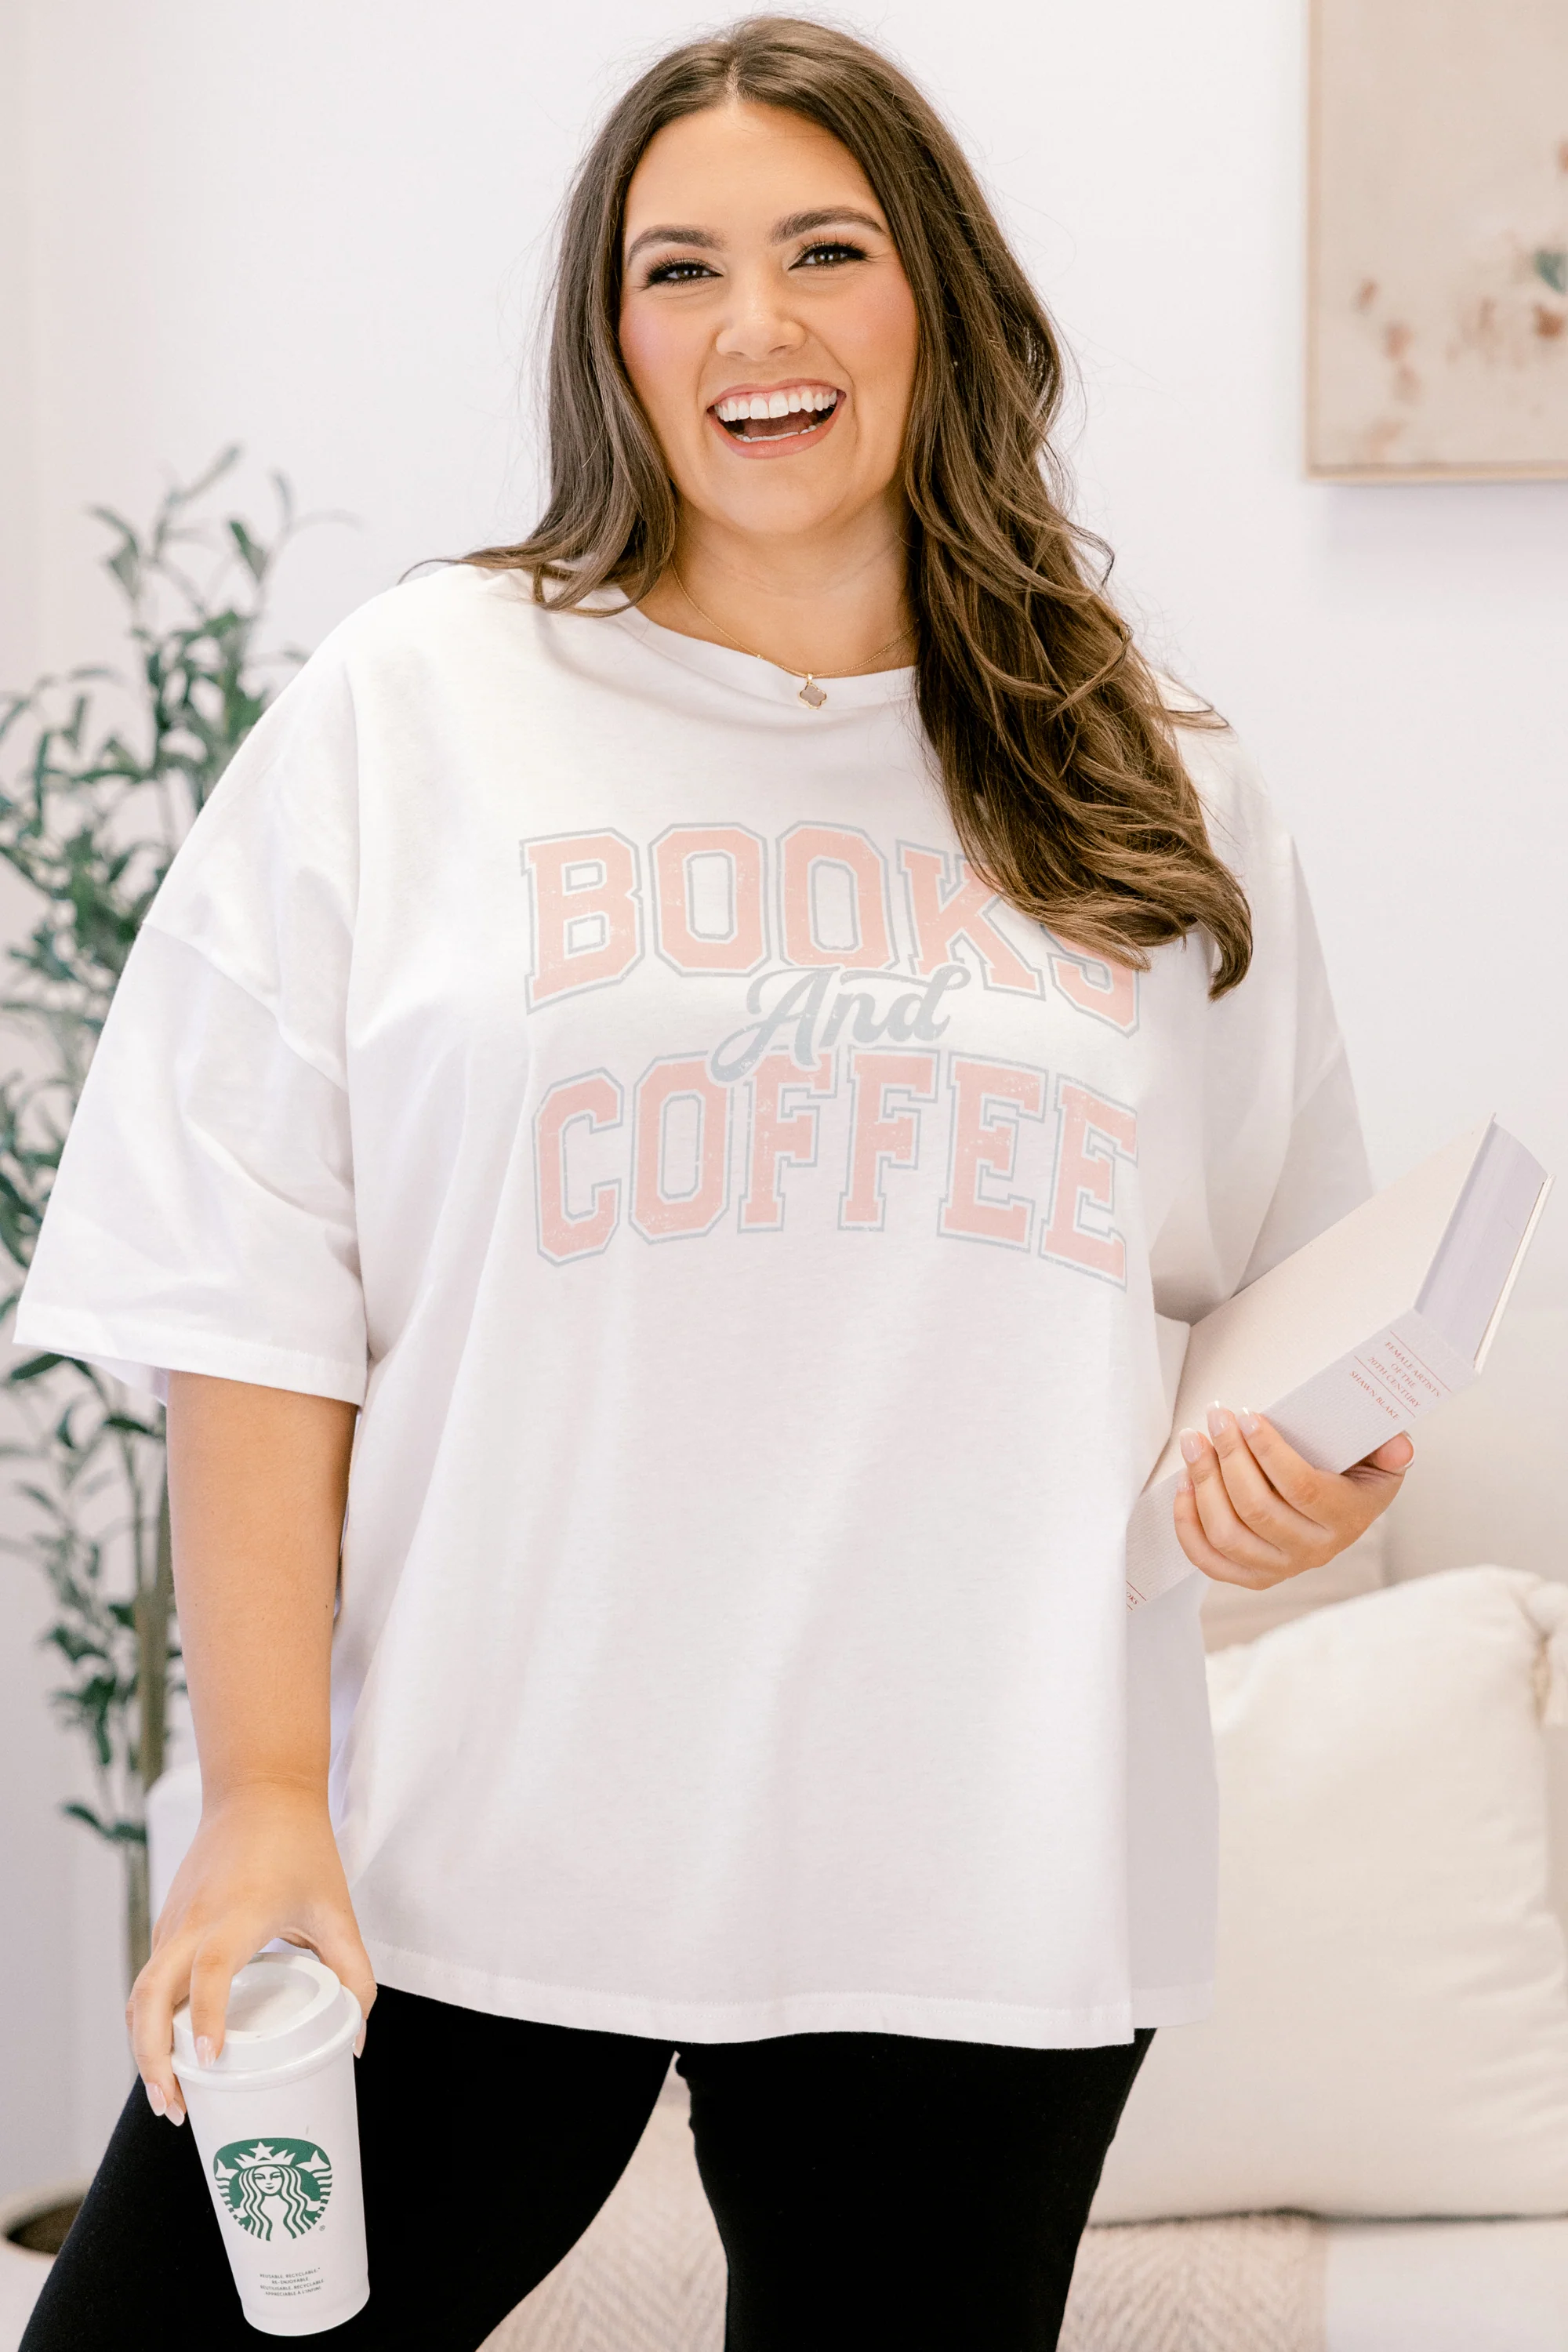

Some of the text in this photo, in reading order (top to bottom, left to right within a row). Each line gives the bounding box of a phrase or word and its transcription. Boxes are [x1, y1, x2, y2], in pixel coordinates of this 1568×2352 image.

[711, 964, 971, 1081] And
[532, 1044, 1138, 1292] COFFEE
[1349, 1370, 1400, 1421] SHAWN BLAKE
[1367, 1356, 1421, 1408] 20TH CENTURY
[1385, 1341, 1441, 1398] FEMALE ARTISTS
[1390, 1363, 1417, 1389] OF THE
